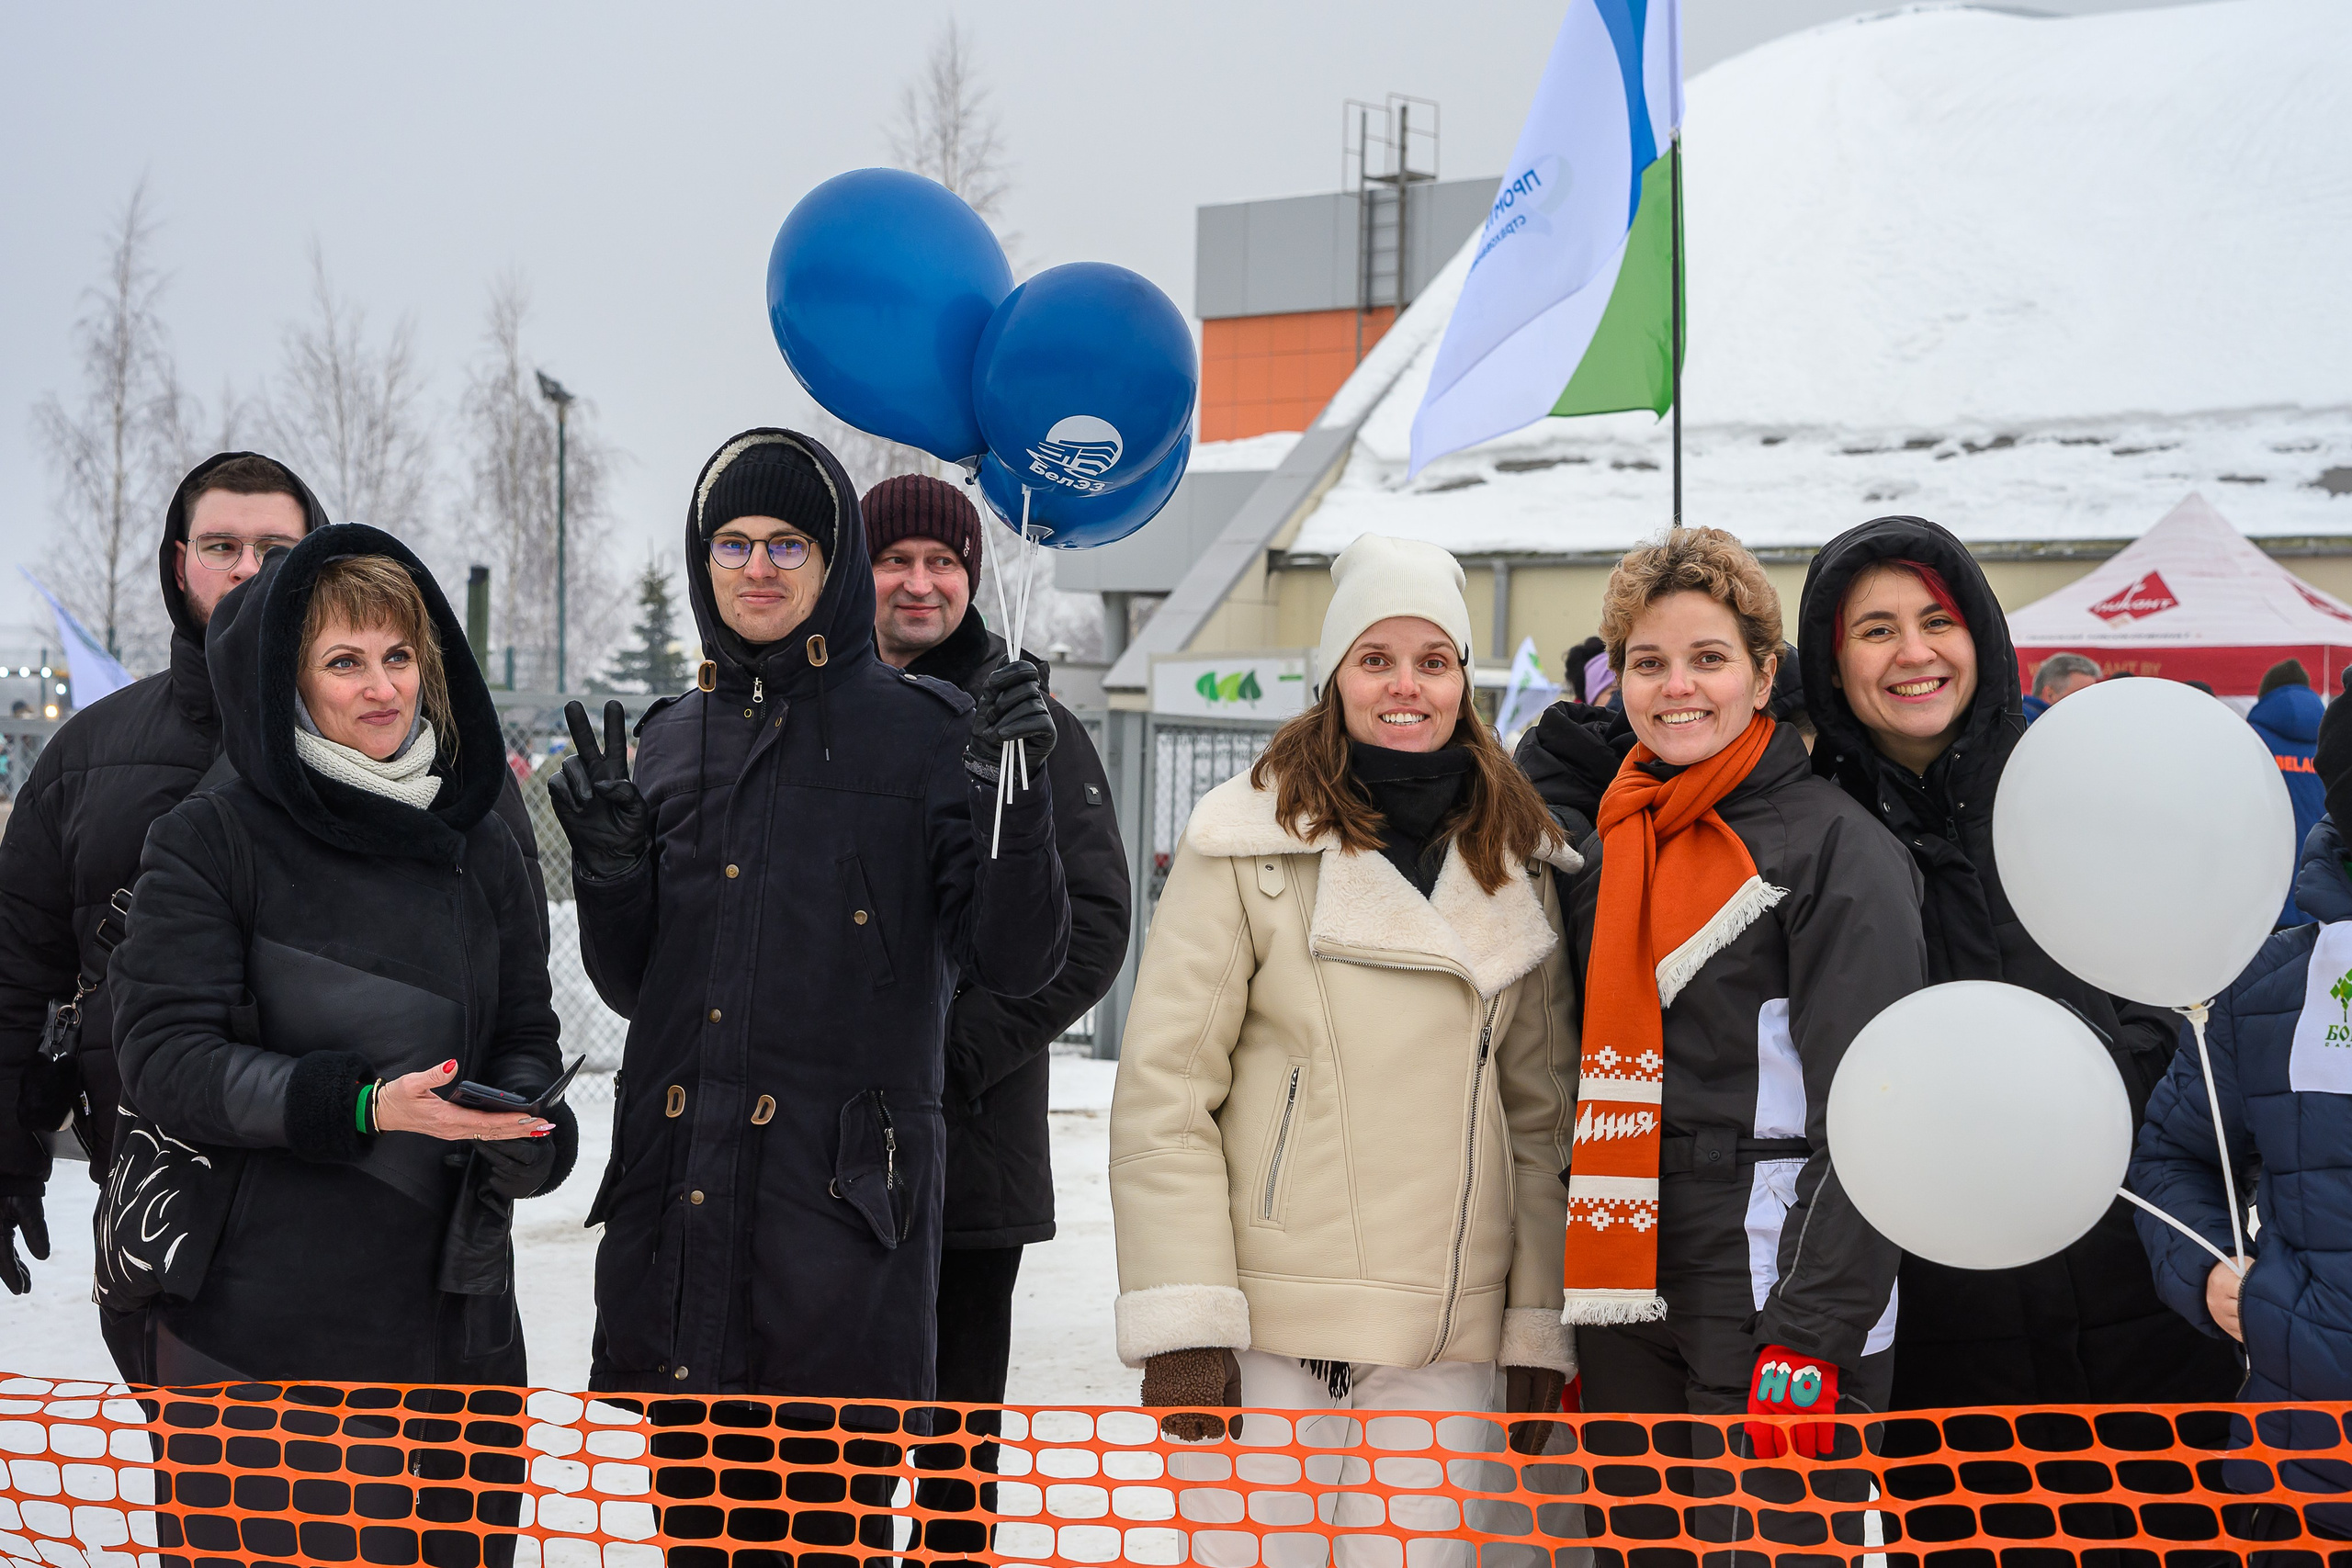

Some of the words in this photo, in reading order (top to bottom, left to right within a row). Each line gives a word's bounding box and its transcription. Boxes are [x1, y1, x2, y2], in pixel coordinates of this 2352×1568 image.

[1029, 460, 1105, 491] БелЭЗ
[2275, 755, 2316, 773] BELA
[2324, 1024, 2352, 1042] БО
[1757, 1360, 1822, 1407] HO
